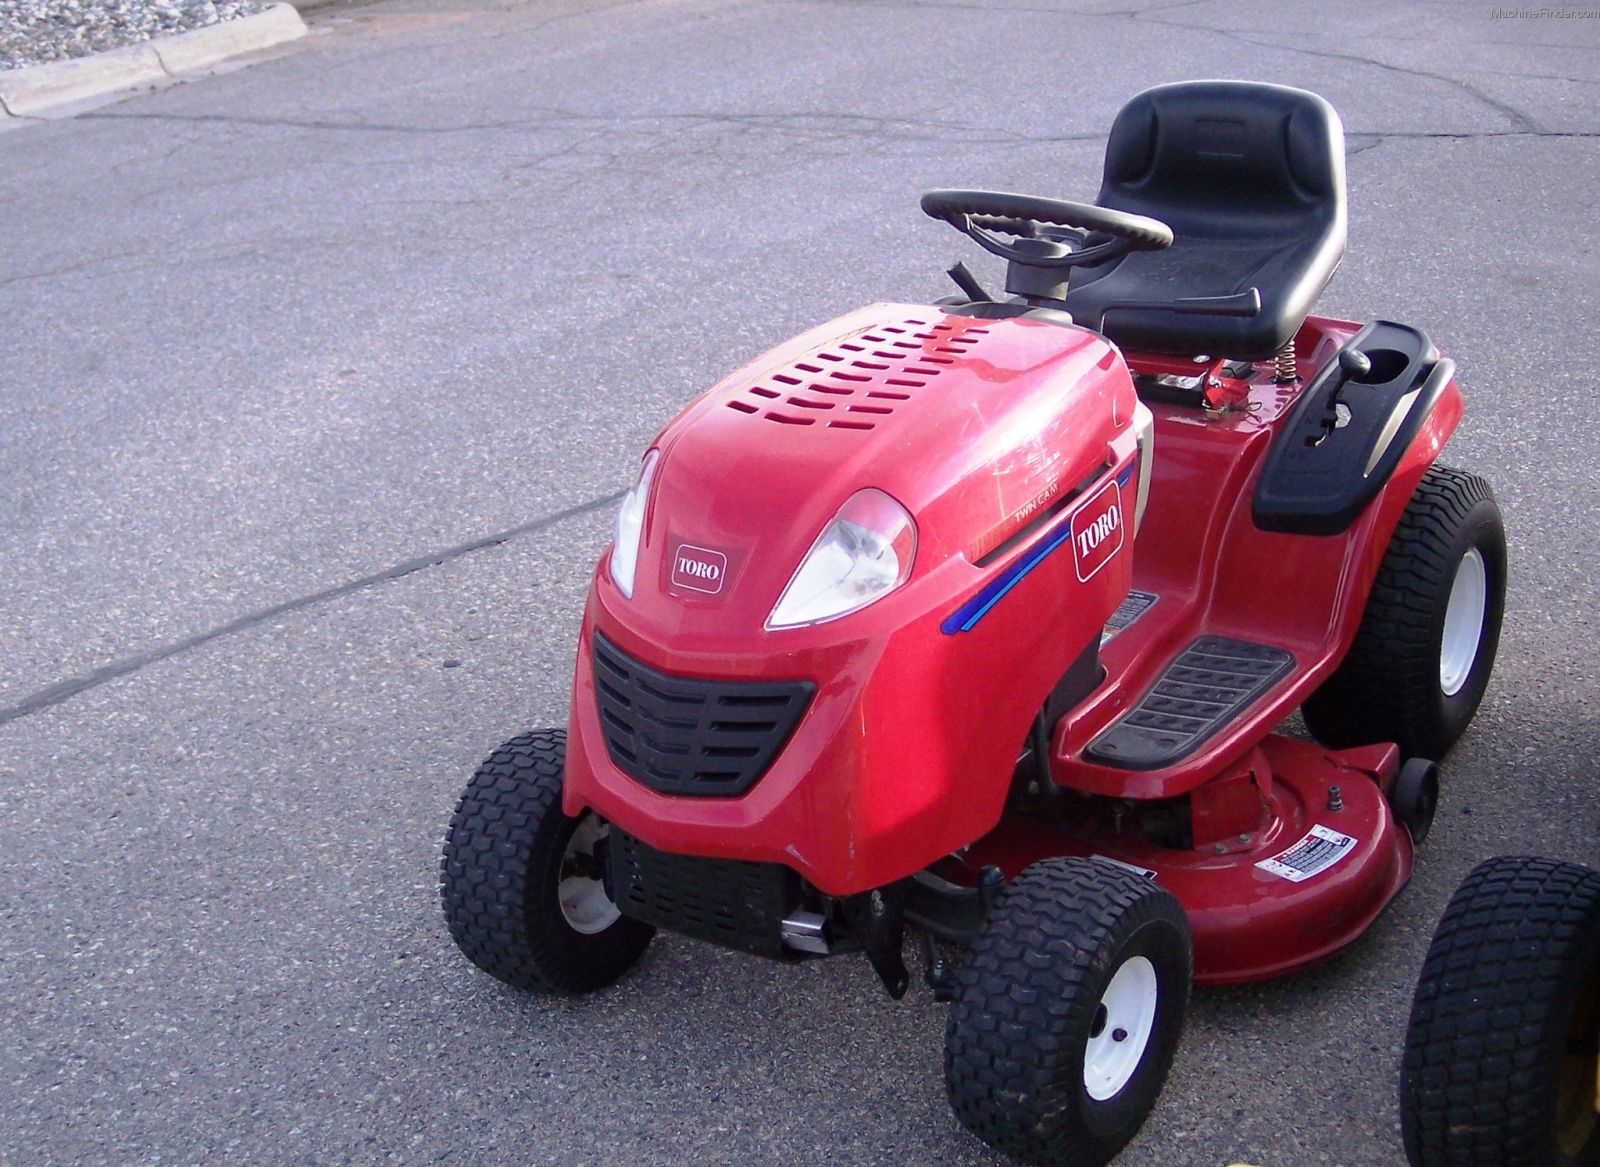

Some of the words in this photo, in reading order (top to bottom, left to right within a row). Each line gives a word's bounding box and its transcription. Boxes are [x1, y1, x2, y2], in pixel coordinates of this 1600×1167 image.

[1015, 501, 1037, 522] TWIN
[1037, 483, 1058, 505] CAM
[1077, 505, 1118, 558] TORO
[679, 557, 719, 580] TORO
